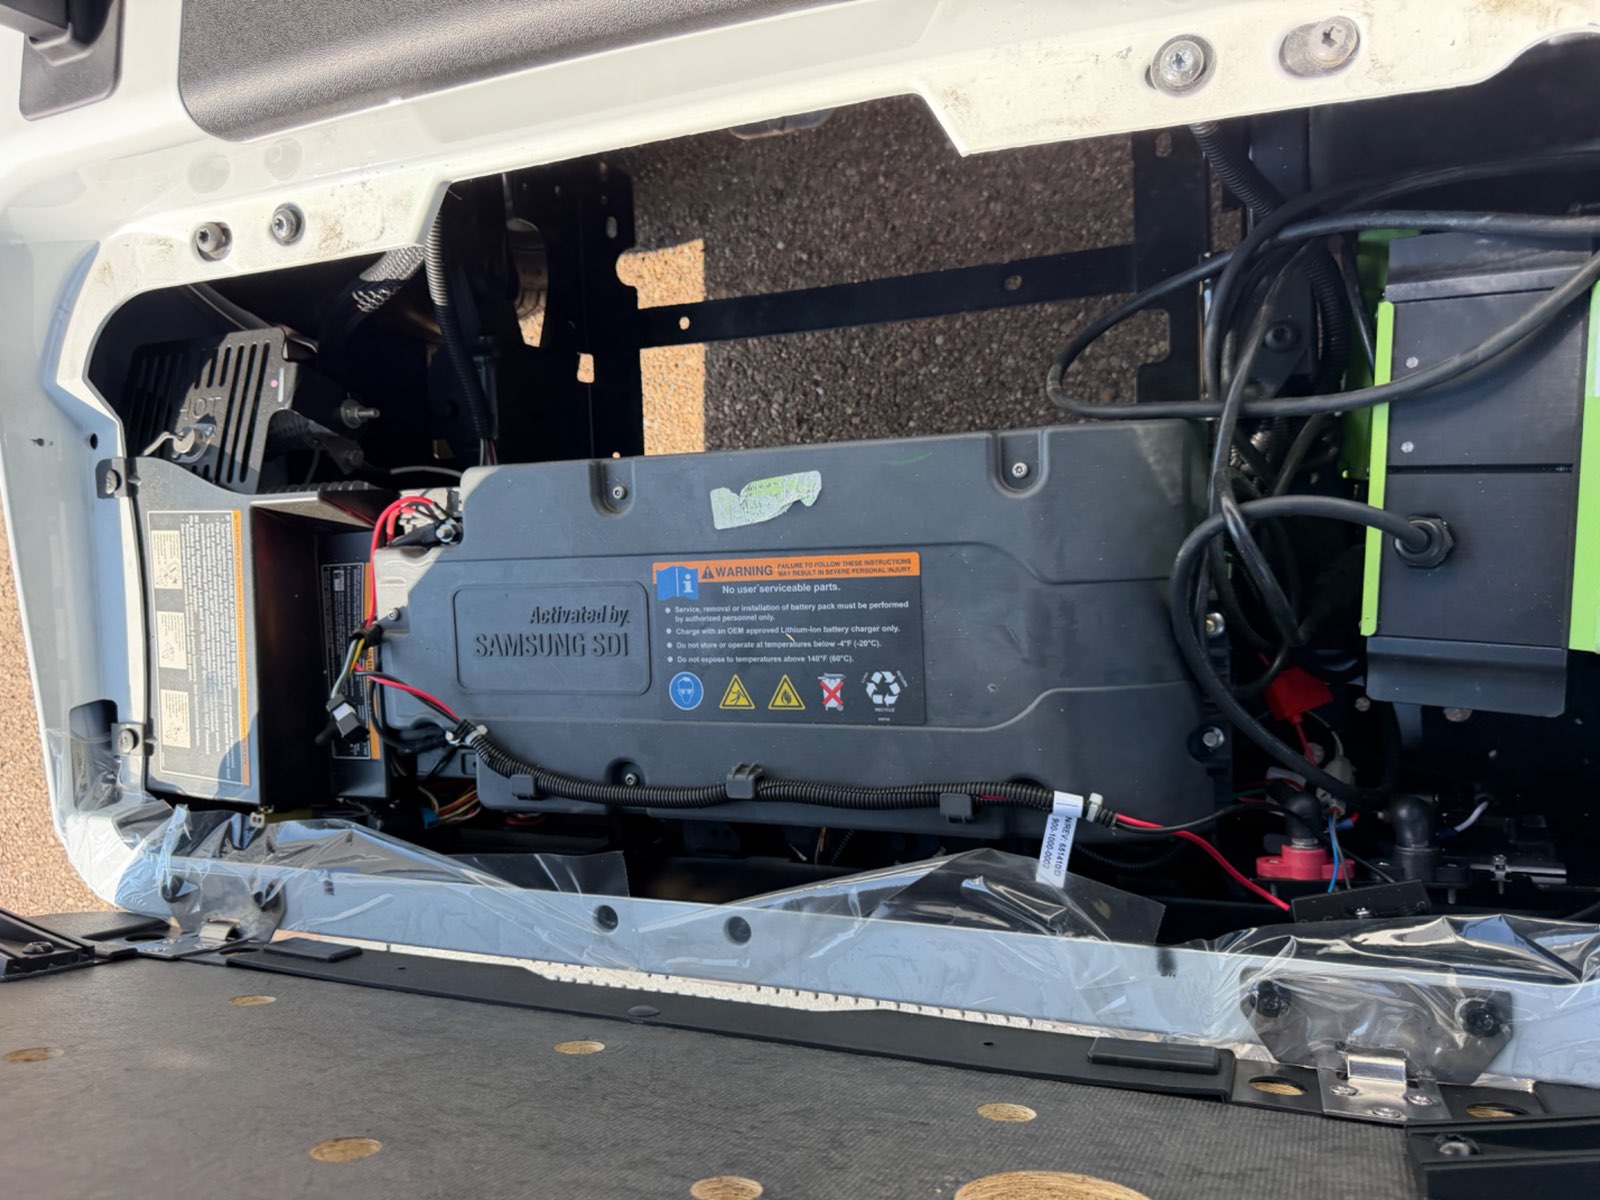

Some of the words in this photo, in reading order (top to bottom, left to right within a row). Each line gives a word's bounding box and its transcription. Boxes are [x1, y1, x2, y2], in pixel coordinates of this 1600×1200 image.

[715, 565, 773, 578] WARNING
[722, 585, 735, 594] No
[759, 583, 811, 593] serviceable
[814, 583, 841, 593] parts.
[790, 604, 816, 612] battery
[818, 603, 836, 611] pack
[869, 601, 909, 610] performed
[530, 605, 607, 624] Activated
[722, 614, 757, 623] personnel
[676, 628, 700, 636] Charge
[746, 627, 779, 635] approved
[823, 626, 849, 634] battery
[851, 625, 880, 634] charger
[881, 625, 900, 633] only.
[475, 632, 586, 658] SAMSUNG
[593, 632, 630, 658] SDI
